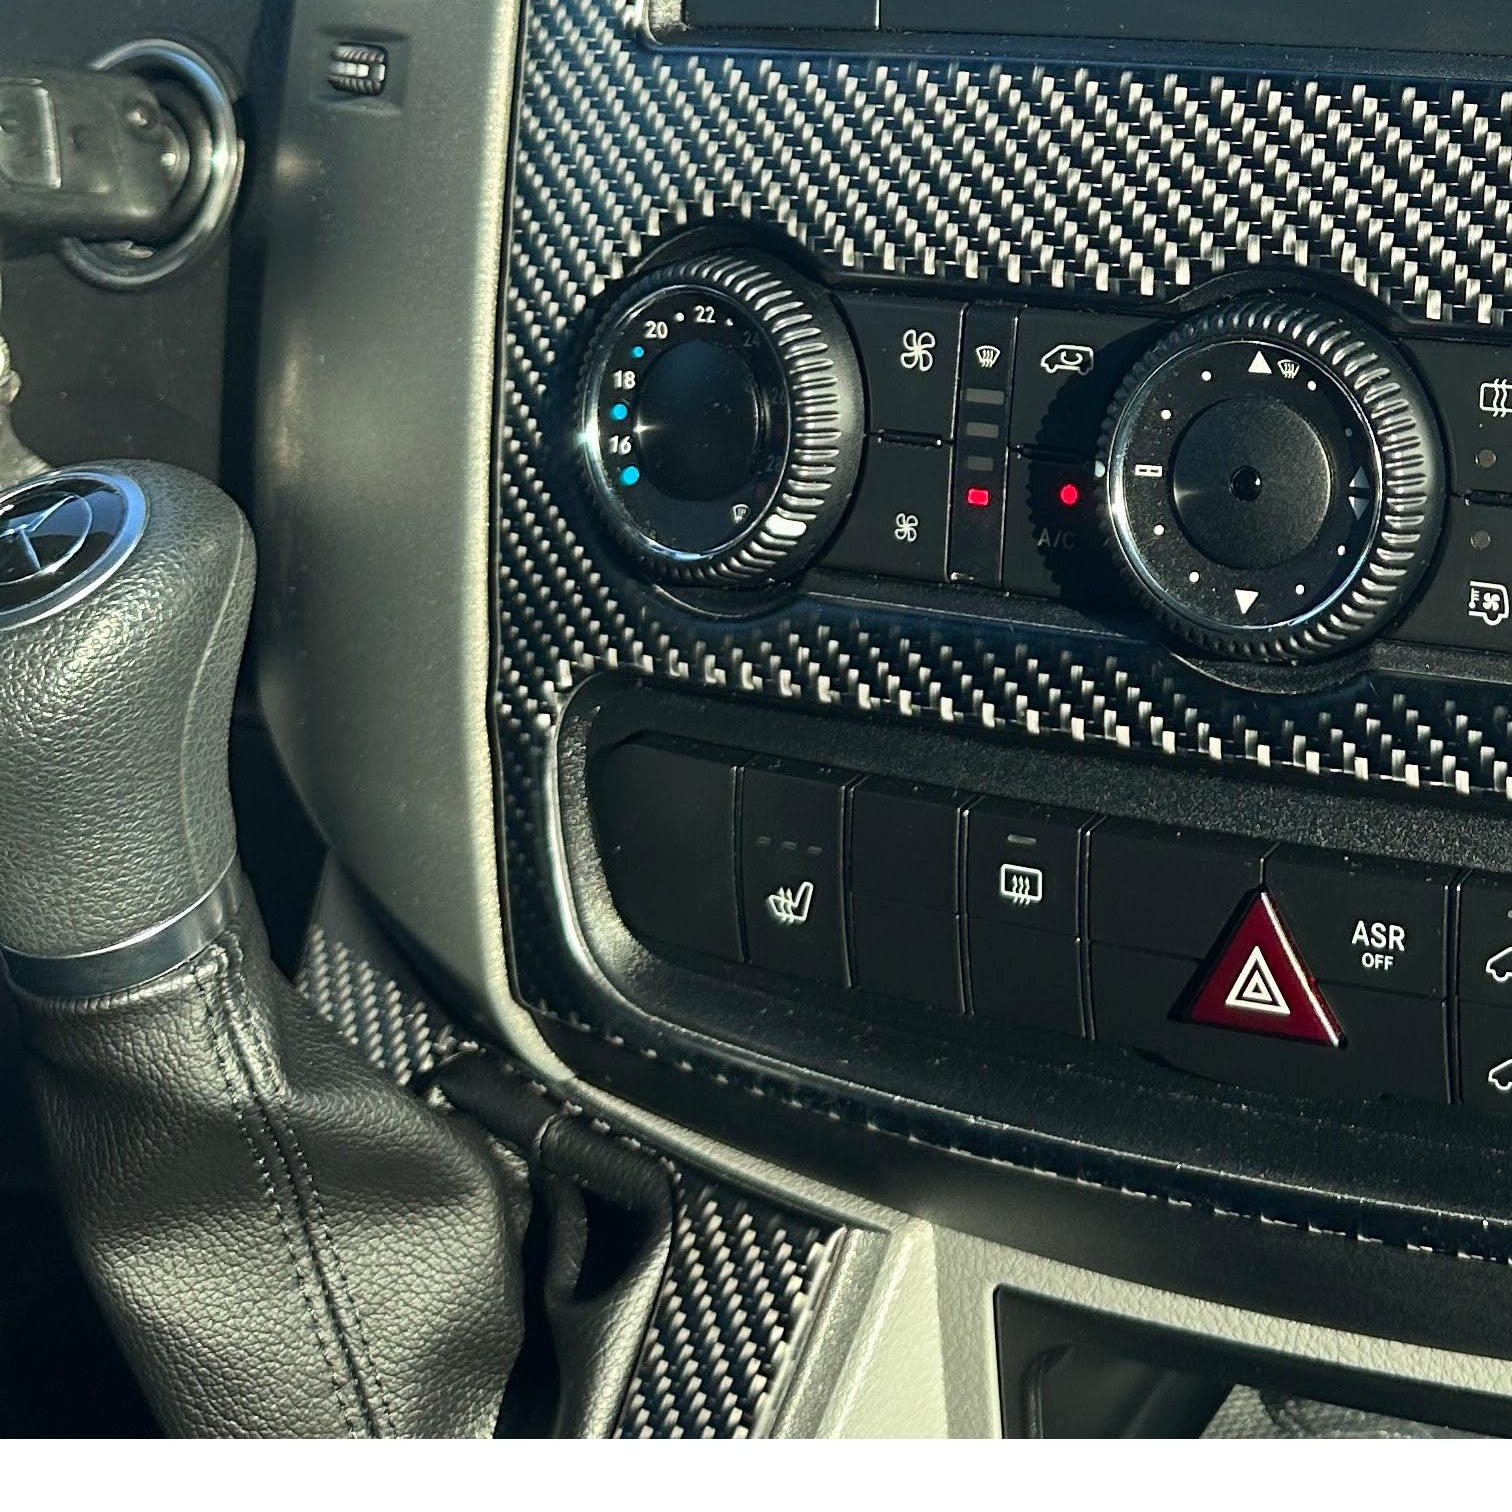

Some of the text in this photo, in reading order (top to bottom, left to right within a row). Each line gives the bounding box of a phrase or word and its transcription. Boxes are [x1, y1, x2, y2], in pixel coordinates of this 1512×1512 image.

[694, 305, 716, 324] 22
[645, 320, 668, 339] 20
[613, 370, 636, 390] 18
[609, 435, 632, 455] 16
[1037, 527, 1075, 550] A/C
[1351, 919, 1406, 952] ASR
[1361, 952, 1394, 971] OFF
